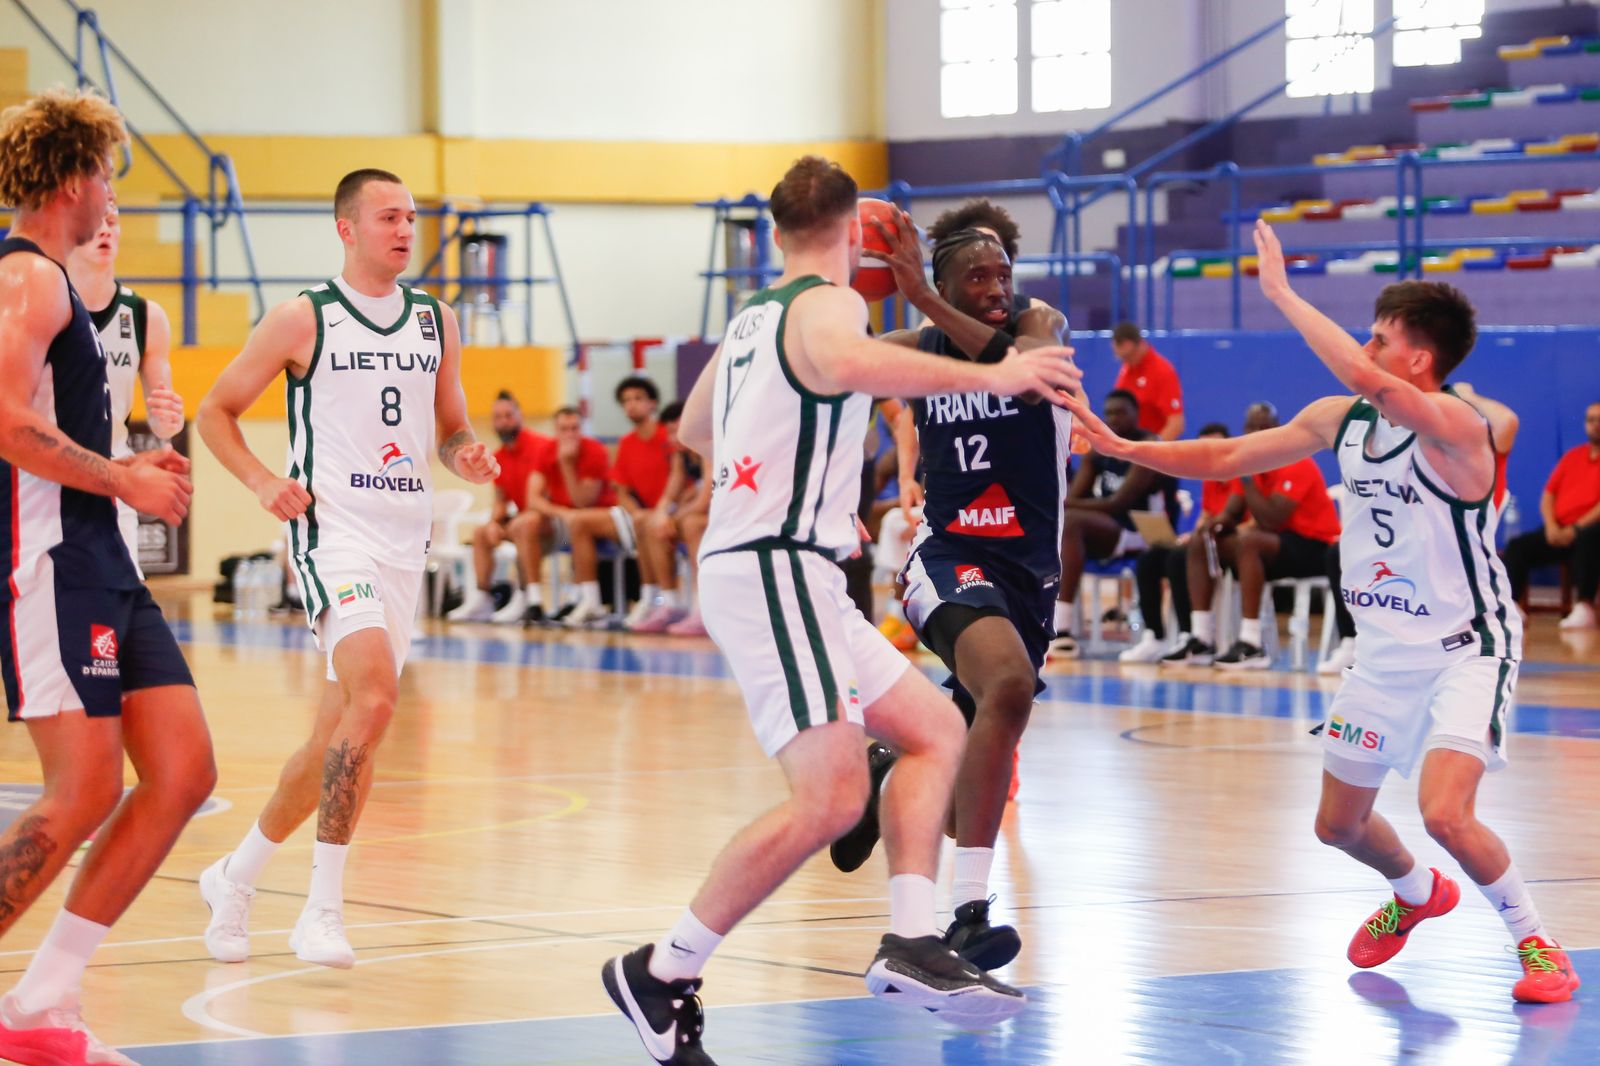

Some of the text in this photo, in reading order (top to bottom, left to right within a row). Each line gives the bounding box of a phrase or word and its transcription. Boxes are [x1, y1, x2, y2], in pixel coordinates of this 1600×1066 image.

[330, 351, 437, 374] LIETUVA
[381, 386, 402, 426] 8
[722, 347, 756, 439] 17
[926, 390, 1019, 425] FRANCE
[954, 434, 991, 472] 12
[350, 473, 425, 492] BIOVELA
[958, 506, 1016, 527] MAIF
[1370, 507, 1395, 548] 5
[1341, 588, 1432, 617] BIOVELA
[1342, 723, 1386, 752] MSI
